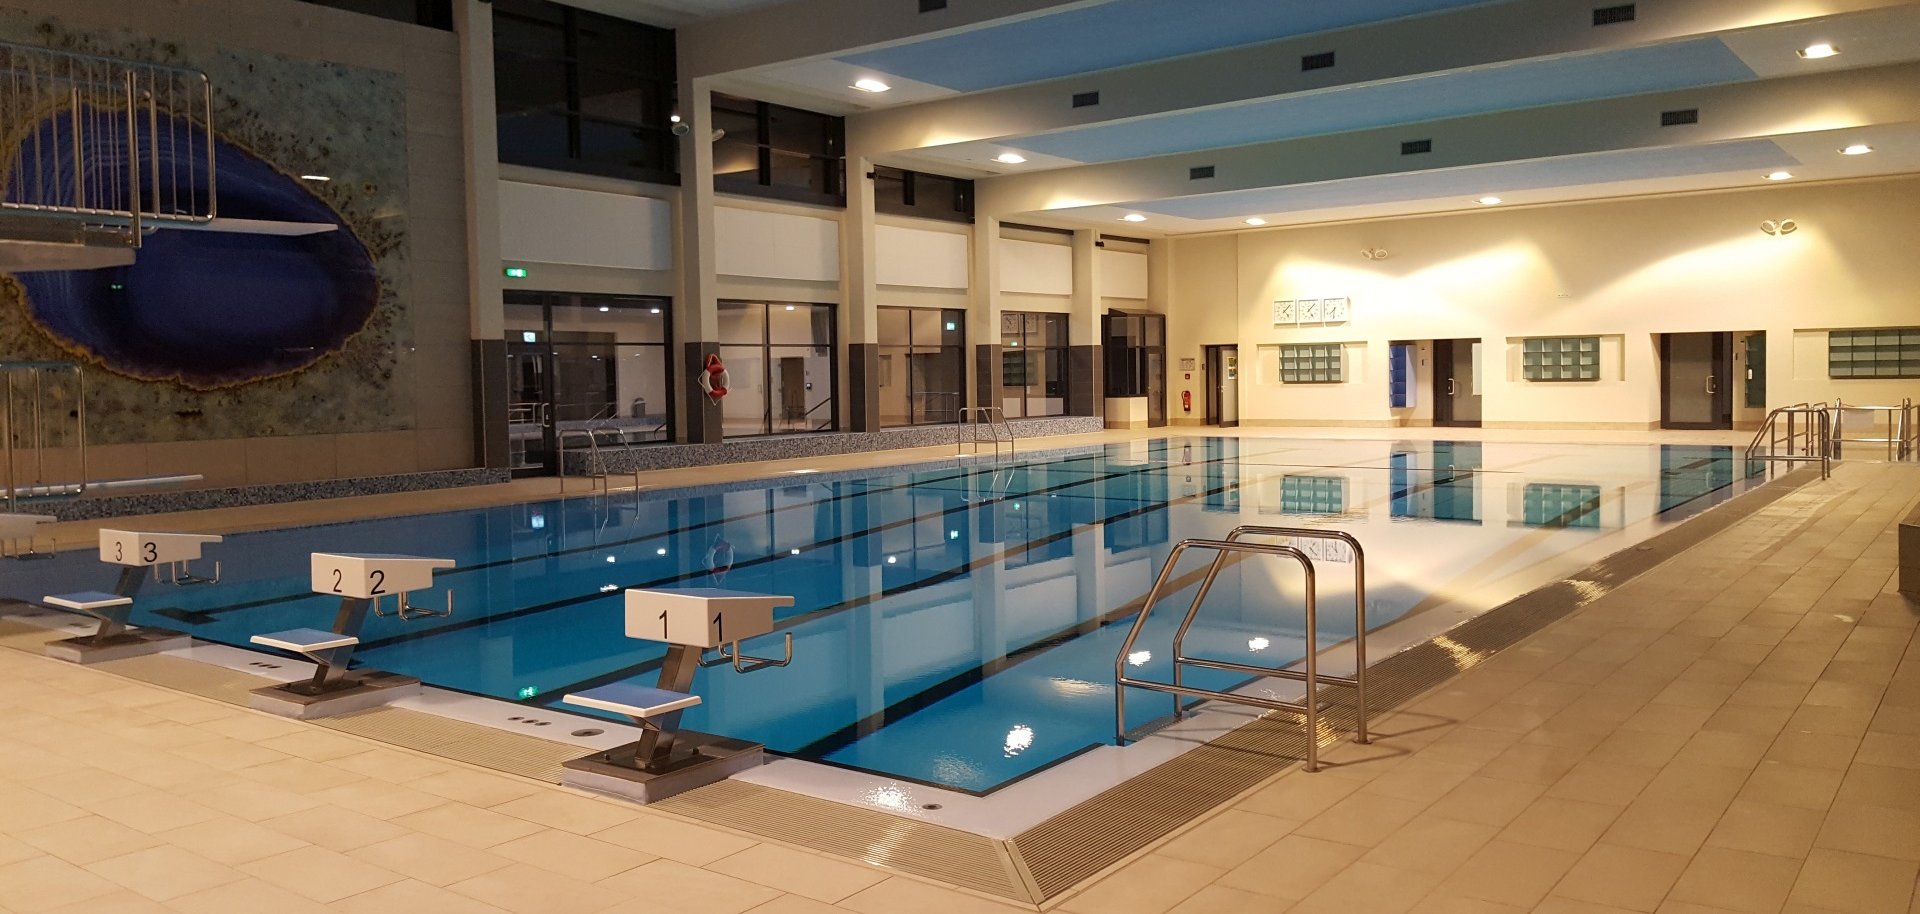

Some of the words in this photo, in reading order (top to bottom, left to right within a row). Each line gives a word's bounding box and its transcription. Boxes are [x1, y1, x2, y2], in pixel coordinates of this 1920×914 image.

[115, 541, 123, 561] 3
[143, 542, 158, 562] 3
[333, 568, 342, 593] 2
[369, 570, 385, 595] 2
[659, 610, 668, 639] 1
[713, 612, 722, 642] 1
